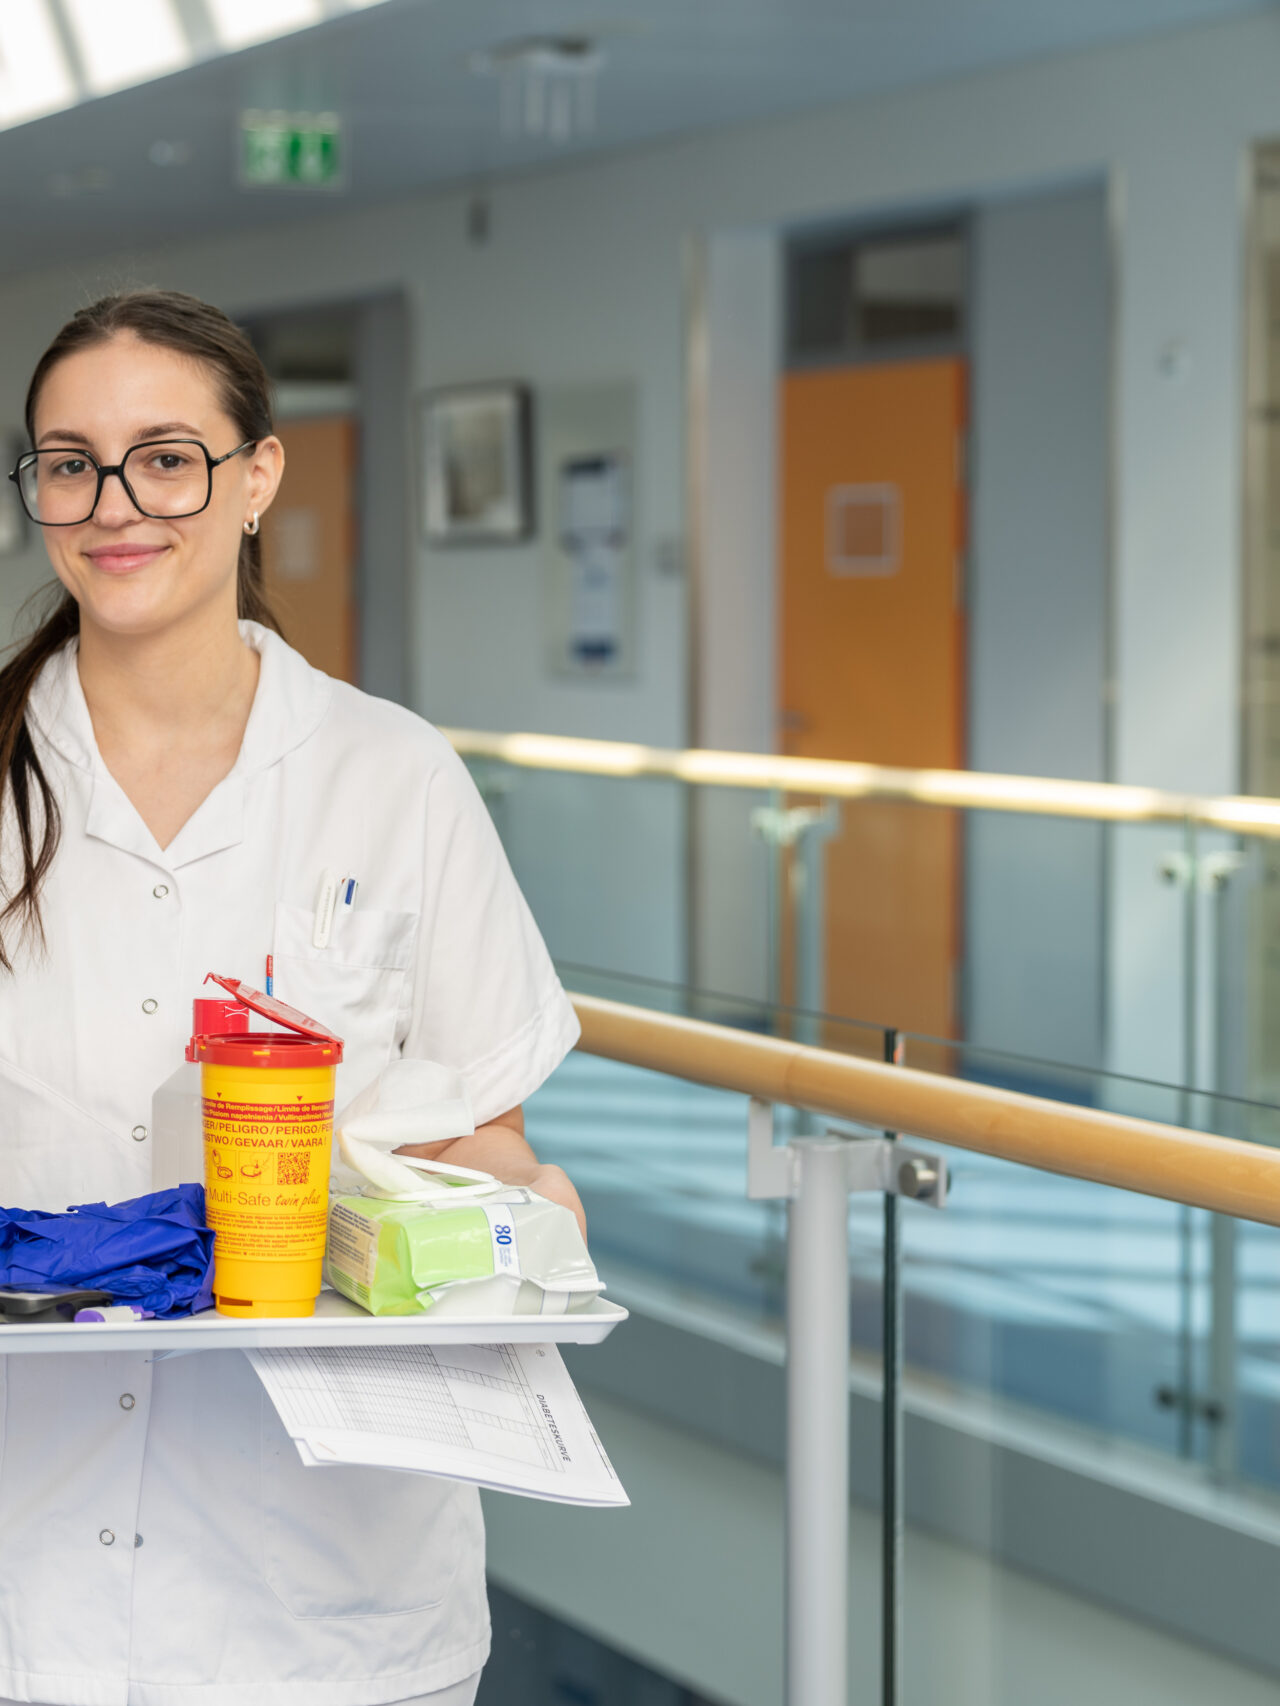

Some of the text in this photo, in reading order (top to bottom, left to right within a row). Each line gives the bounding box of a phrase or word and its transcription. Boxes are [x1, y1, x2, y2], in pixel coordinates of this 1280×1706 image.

[209, 1188, 321, 1212] Multi-Safe twin plus
[494, 1224, 512, 1245] 80
[536, 1393, 572, 1462] DIABETESKURVE
